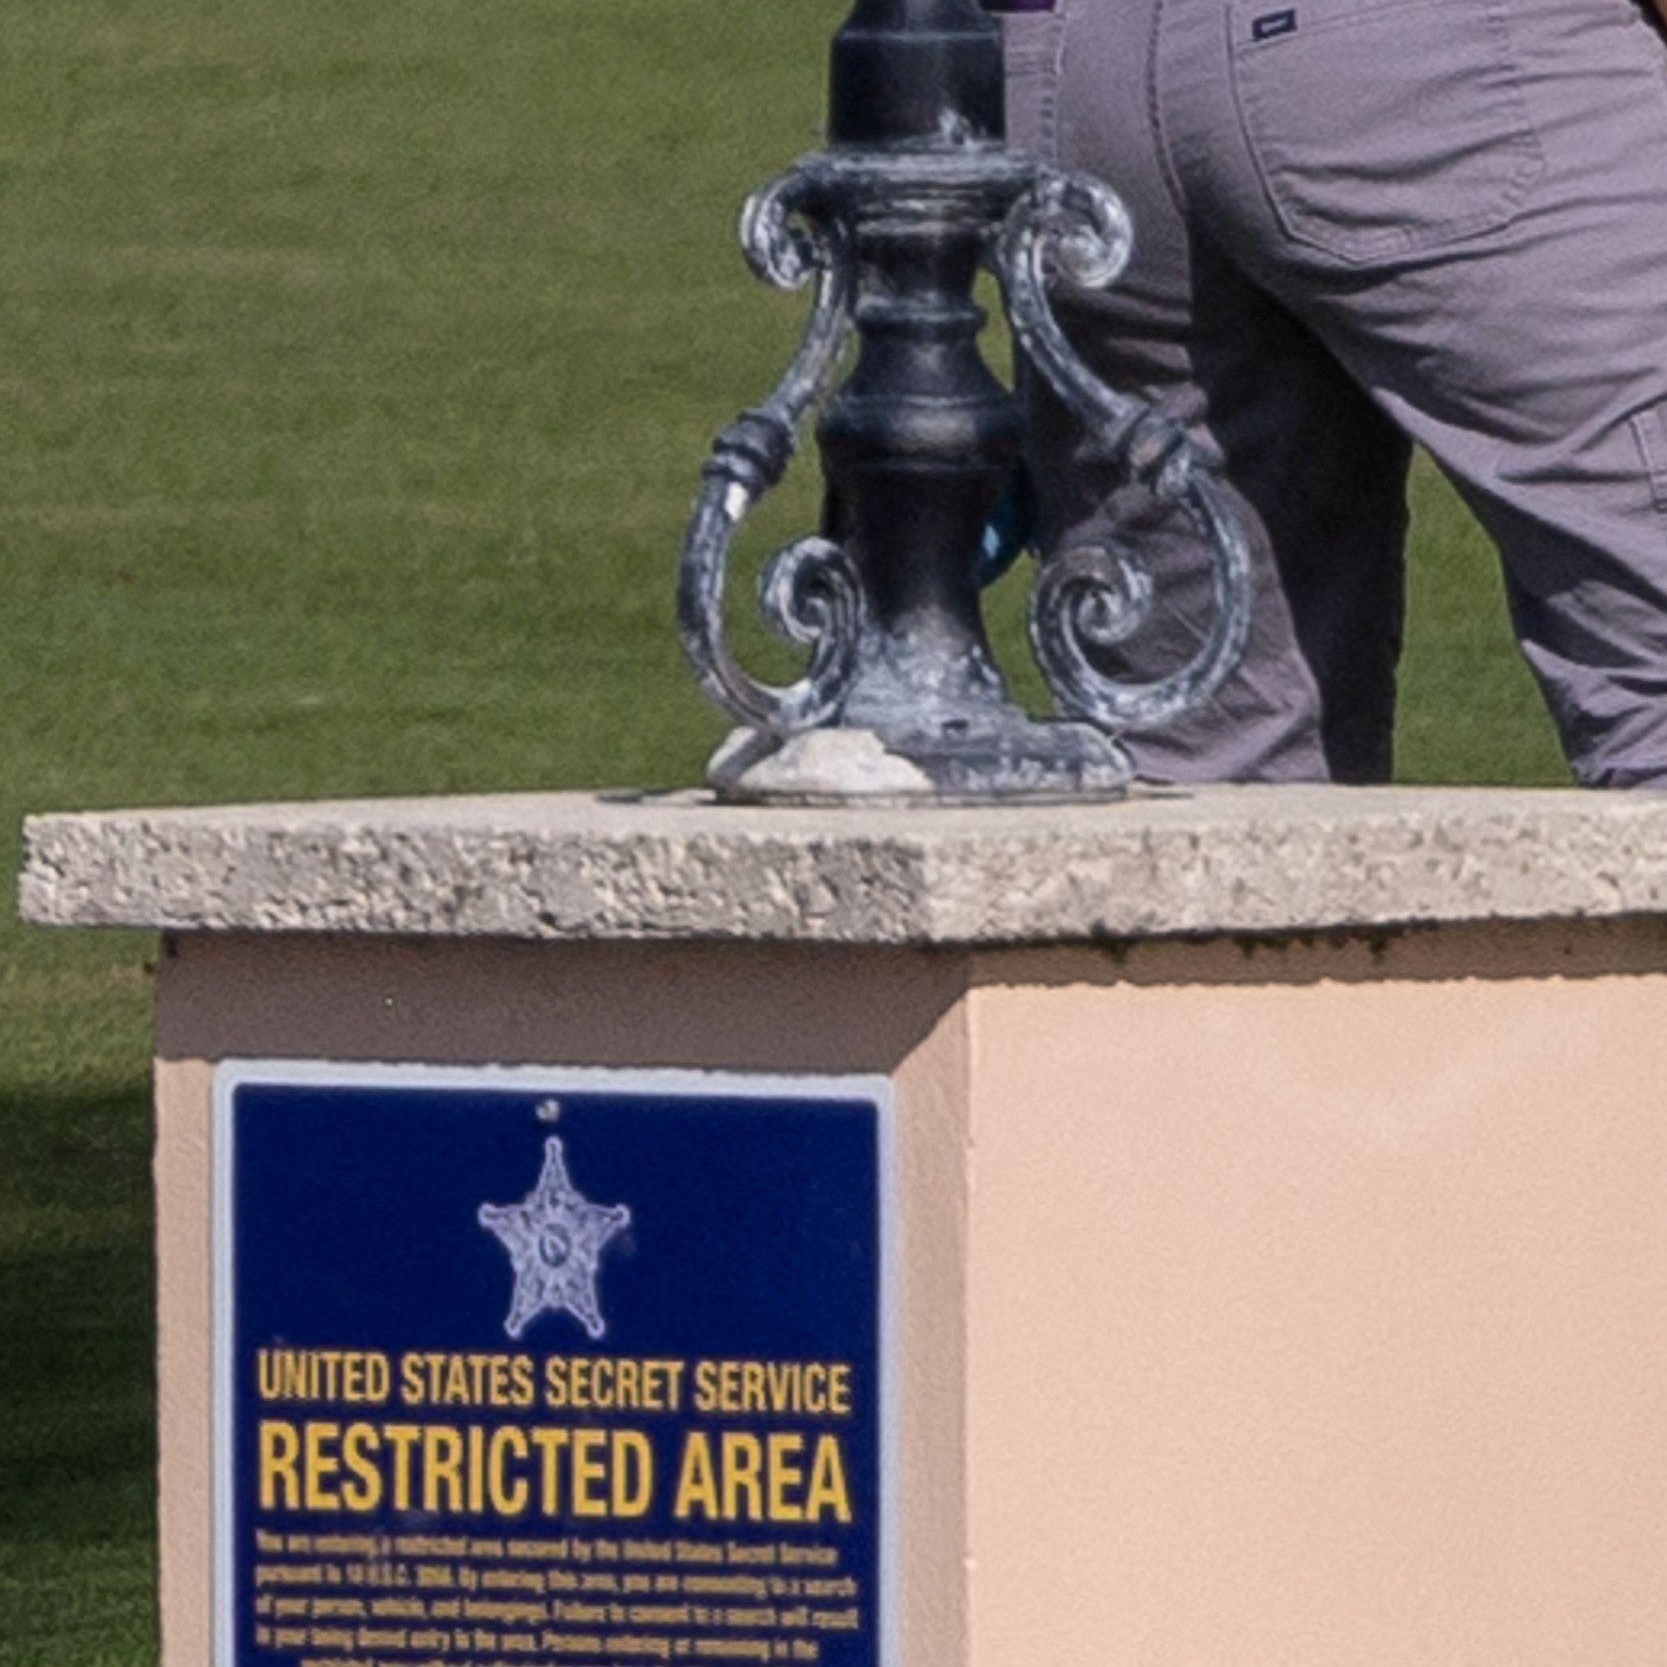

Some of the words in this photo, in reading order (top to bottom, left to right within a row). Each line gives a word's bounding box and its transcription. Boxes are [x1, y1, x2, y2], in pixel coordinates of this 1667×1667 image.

[257, 1348, 390, 1404] UNITED
[399, 1352, 535, 1408] STATES
[544, 1355, 684, 1411] SECRET
[695, 1361, 852, 1415] SERVICE
[258, 1421, 653, 1519] RESTRICTED
[674, 1432, 852, 1524] AREA
